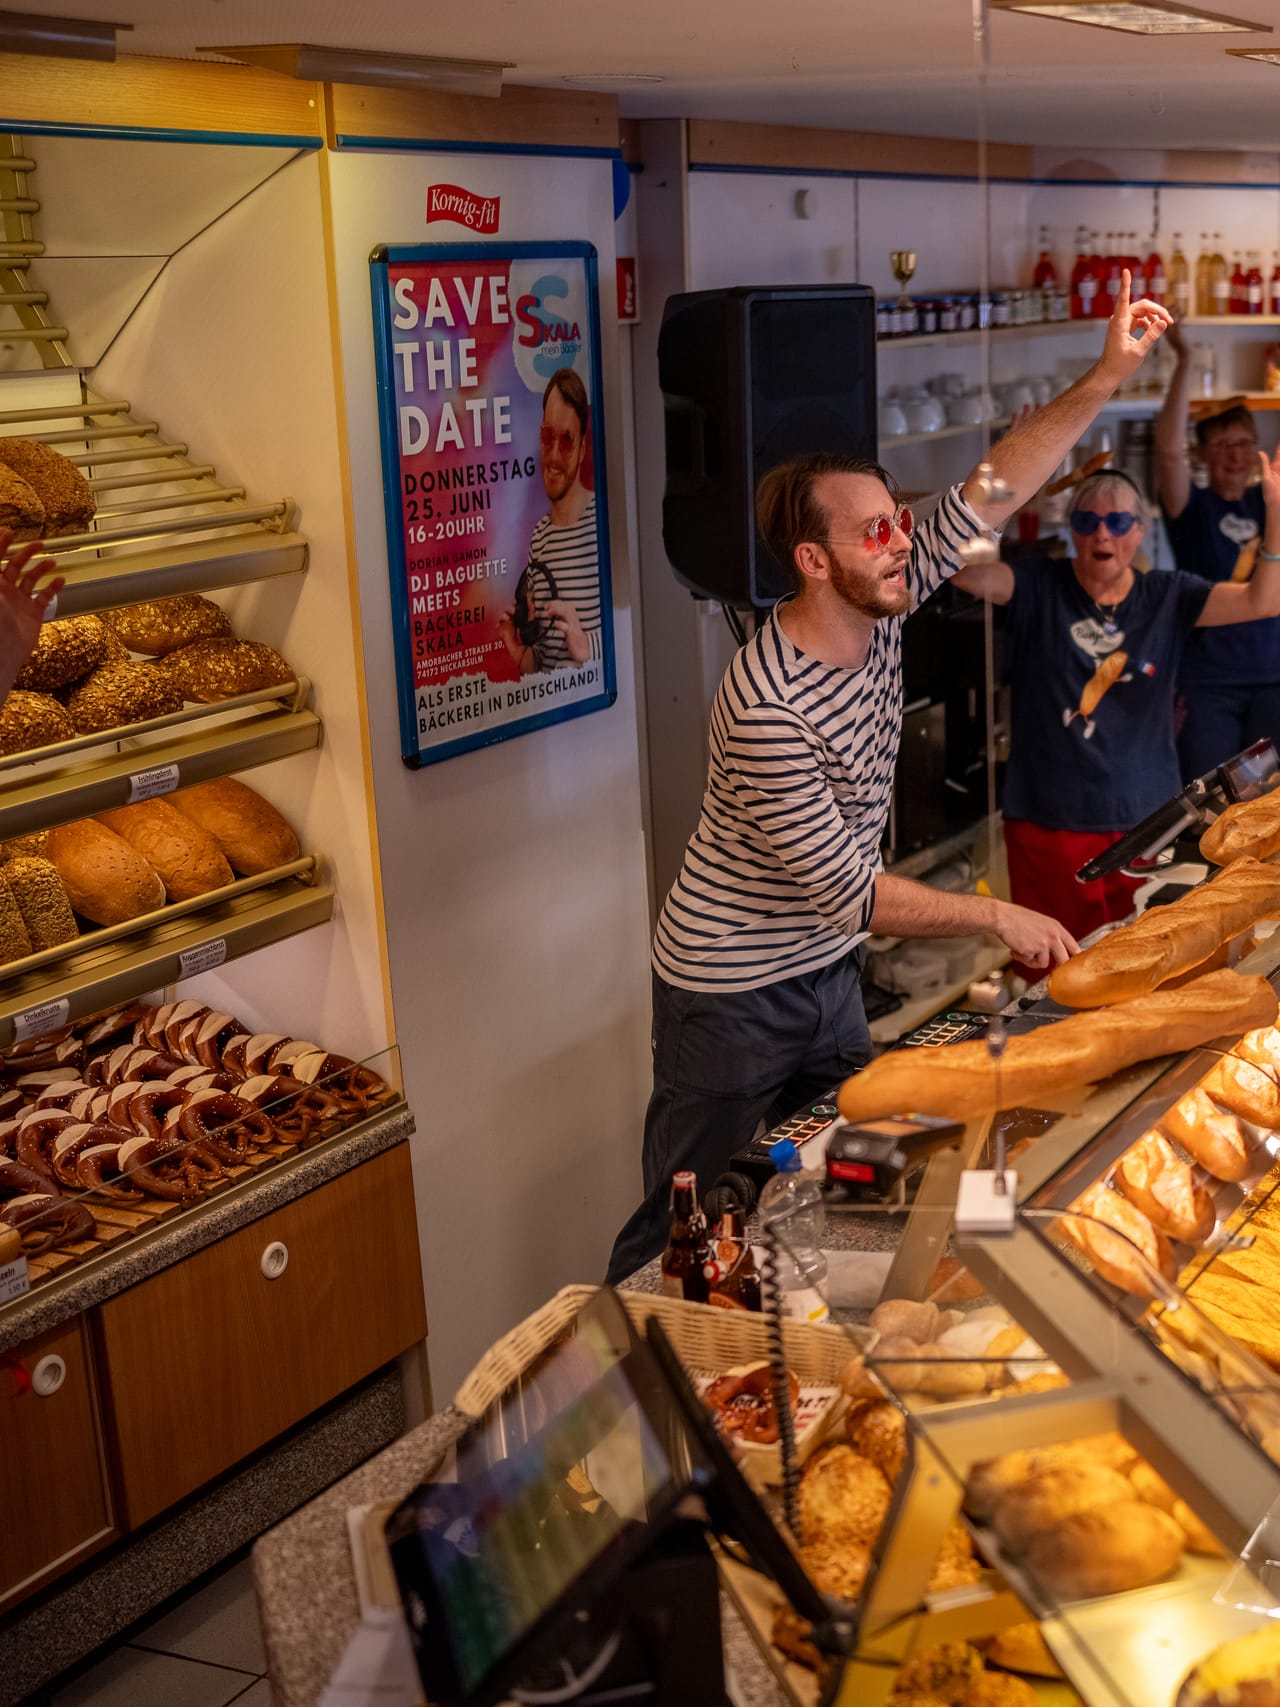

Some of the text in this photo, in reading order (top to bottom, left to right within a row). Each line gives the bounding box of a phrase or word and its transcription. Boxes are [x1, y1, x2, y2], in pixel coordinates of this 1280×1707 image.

[393, 275, 509, 330] SAVE
[516, 294, 581, 347] SKALA
[394, 338, 479, 393] THE
[400, 396, 512, 456] DATE
[404, 456, 536, 495] DONNERSTAG
[406, 489, 491, 521] 25. JUNI
[408, 516, 486, 544] 16-20UHR
[409, 547, 487, 571] DORIAN GAMON
[410, 558, 508, 593] DJ BAGUETTE
[412, 588, 461, 615] MEETS
[414, 606, 486, 637] BÄCKEREI
[416, 630, 465, 656] SKALA
[416, 650, 463, 670] AMORBACHER
[464, 643, 492, 657] STRASSE
[416, 655, 484, 680] 74172 NECKARSULM
[418, 678, 487, 711] ALS ERSTE
[419, 668, 599, 733] BÄCKEREI IN DEUTSCHLAND!
